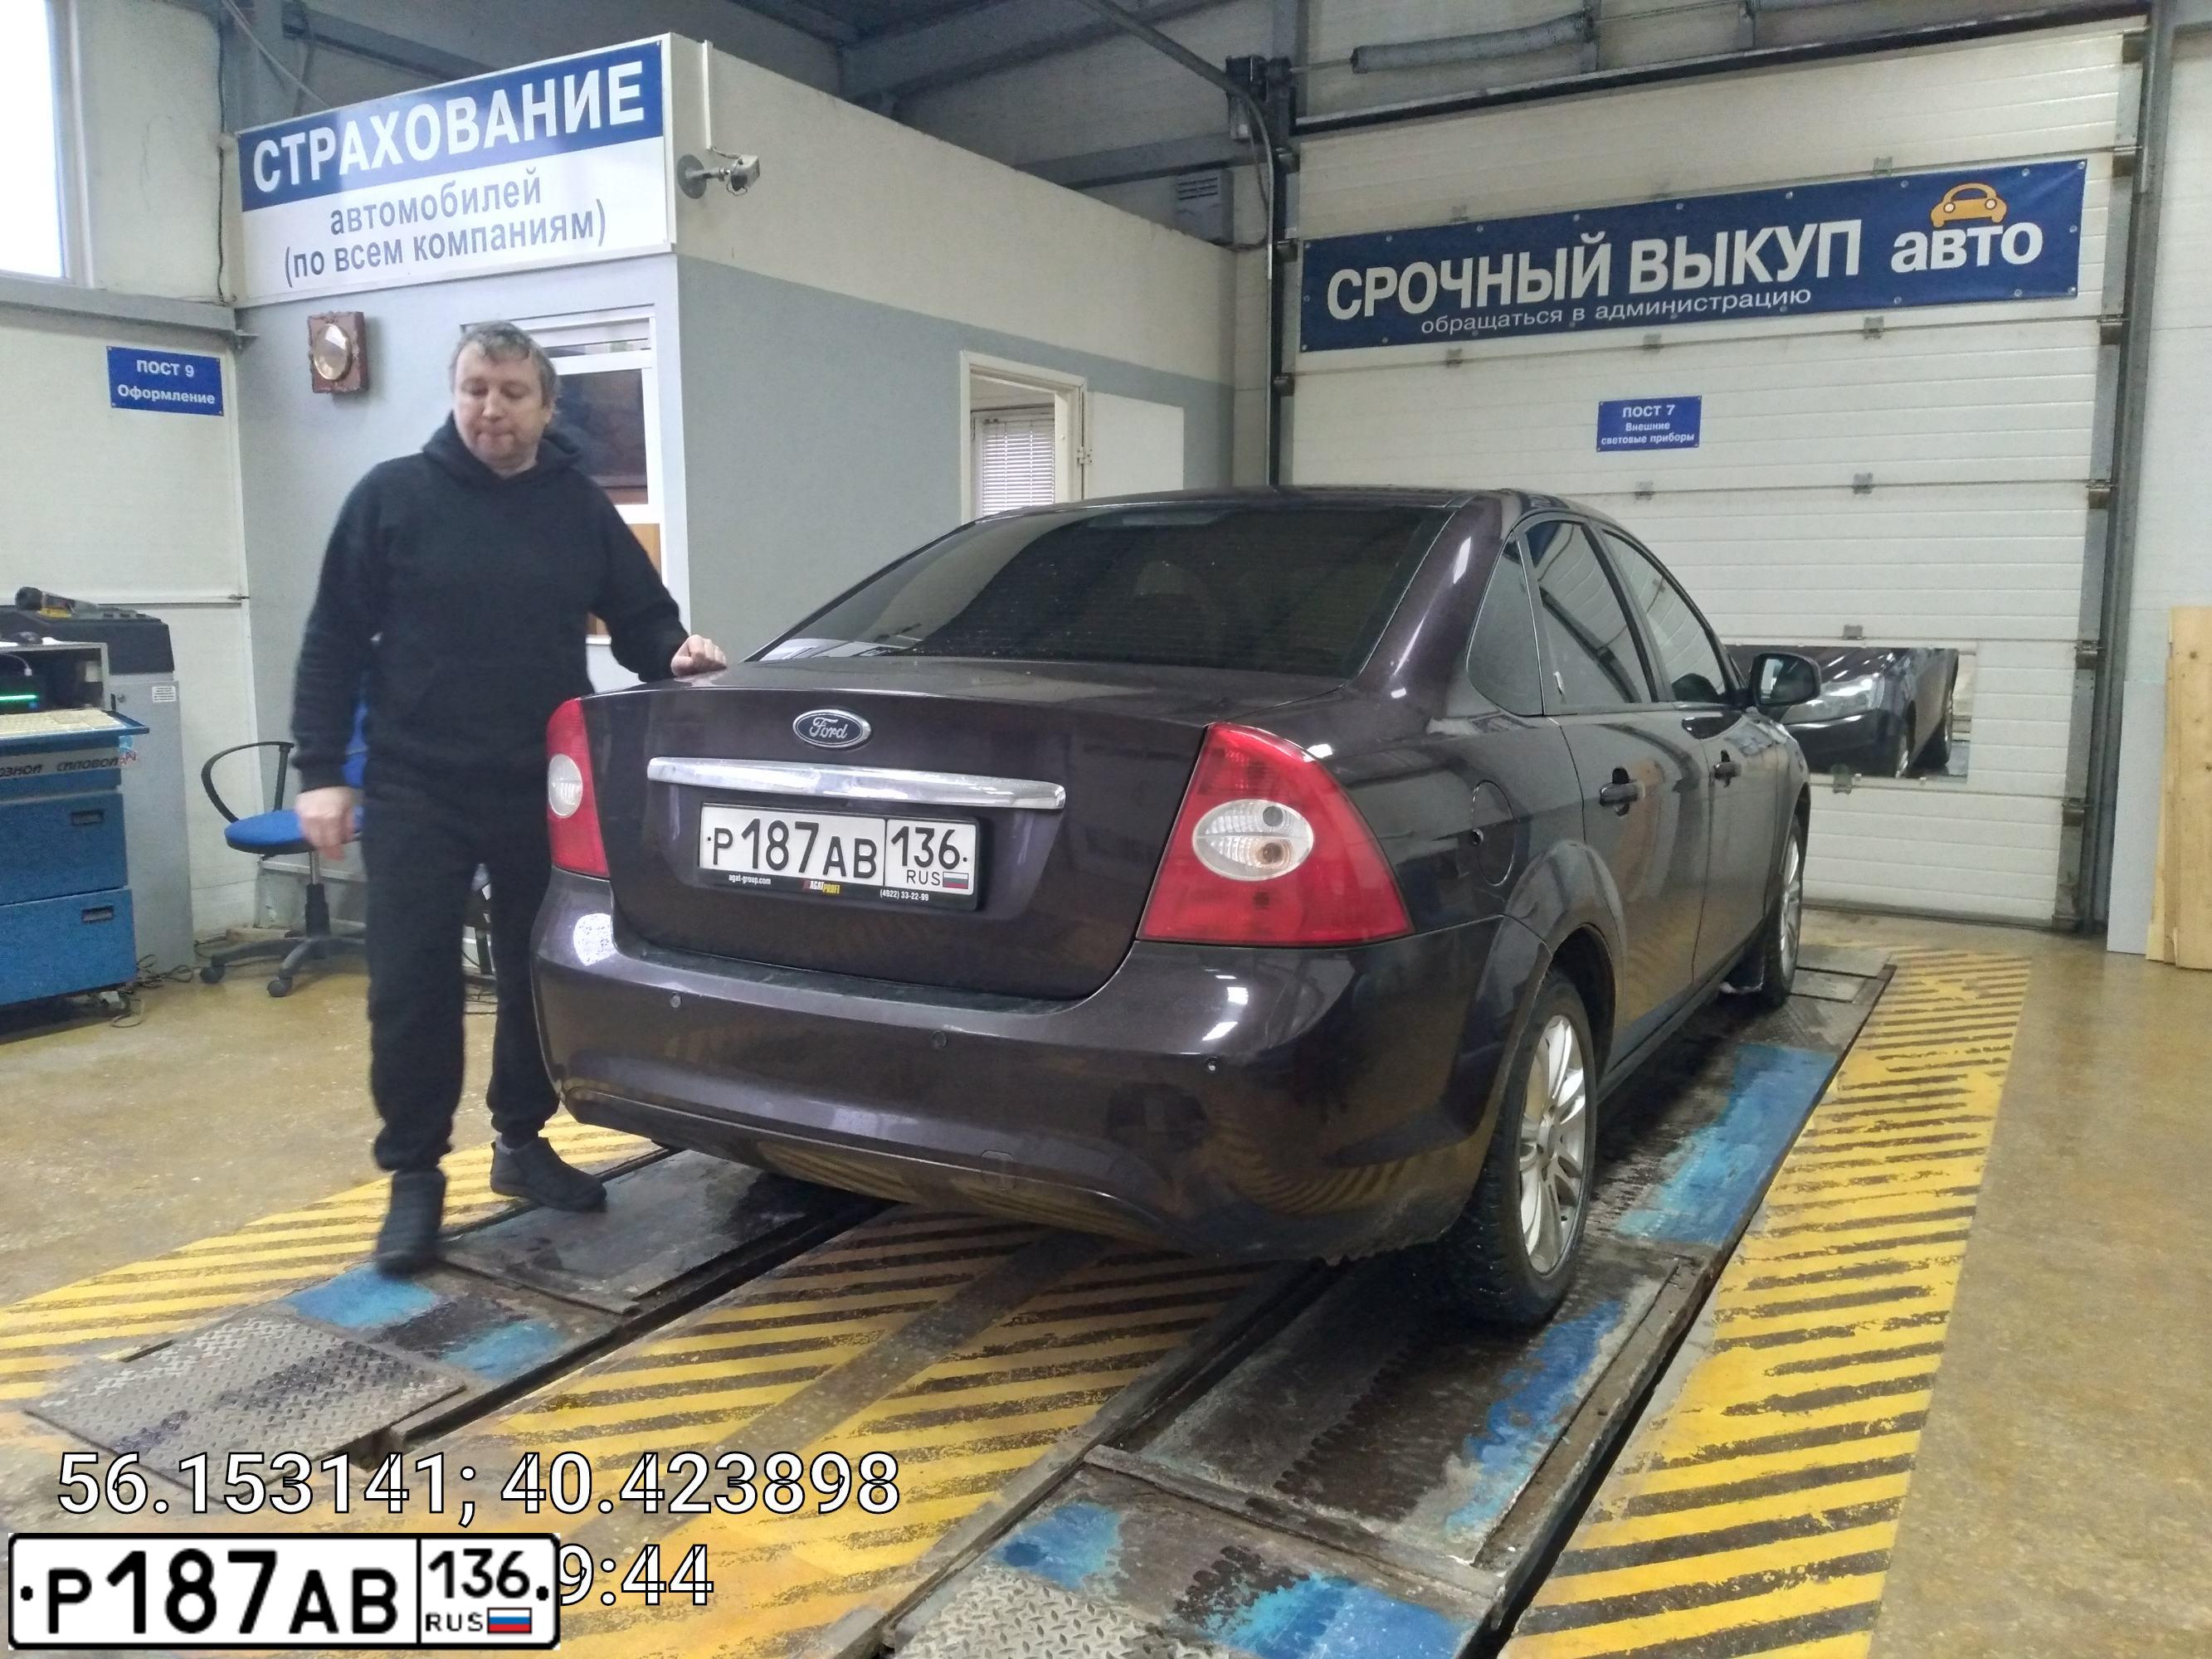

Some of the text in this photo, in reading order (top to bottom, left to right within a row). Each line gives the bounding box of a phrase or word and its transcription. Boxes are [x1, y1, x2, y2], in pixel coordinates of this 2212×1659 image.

[253, 61, 644, 193] СТРАХОВАНИЕ
[330, 168, 541, 236] автомобилей
[285, 198, 606, 288] (по всем компаниям)
[1328, 219, 2044, 320] СРОЧНЫЙ ВЫКУП авто
[1421, 288, 1811, 334] обращаться в администрацию
[136, 359, 194, 377] ПОСТ 9
[117, 384, 216, 404] Оформление
[1623, 404, 1675, 417] ПОСТ 7
[1625, 421, 1670, 431] Внешние
[1601, 431, 1694, 445] световые приборы
[809, 717, 849, 739] Ford
[891, 825, 961, 869] 136
[728, 874, 772, 885] agat-group.com
[906, 870, 941, 886] RUS
[879, 888, 929, 902] (4922) 33-22-99
